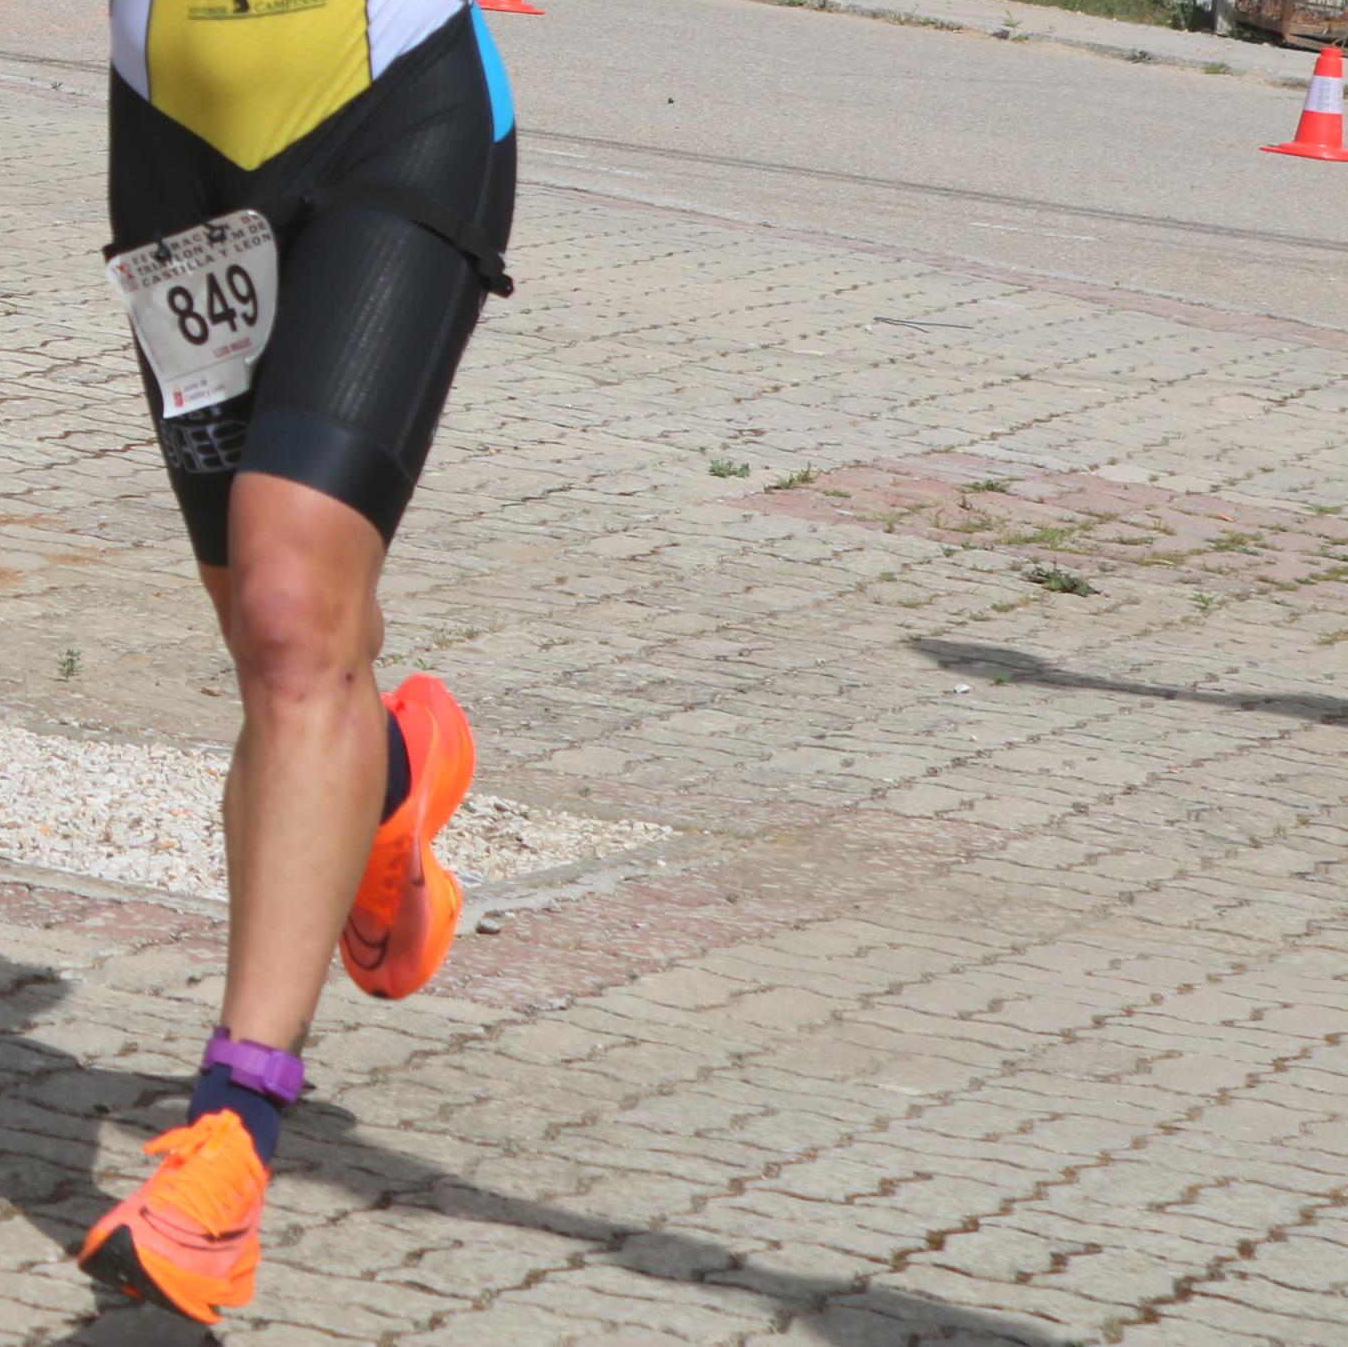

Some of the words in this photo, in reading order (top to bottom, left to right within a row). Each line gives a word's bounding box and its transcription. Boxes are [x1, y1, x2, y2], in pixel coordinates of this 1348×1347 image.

[248, 220, 267, 234] DE
[141, 253, 216, 288] CASTILLA
[218, 247, 228, 258] Y
[233, 233, 271, 253] LEON
[166, 264, 258, 346] 849
